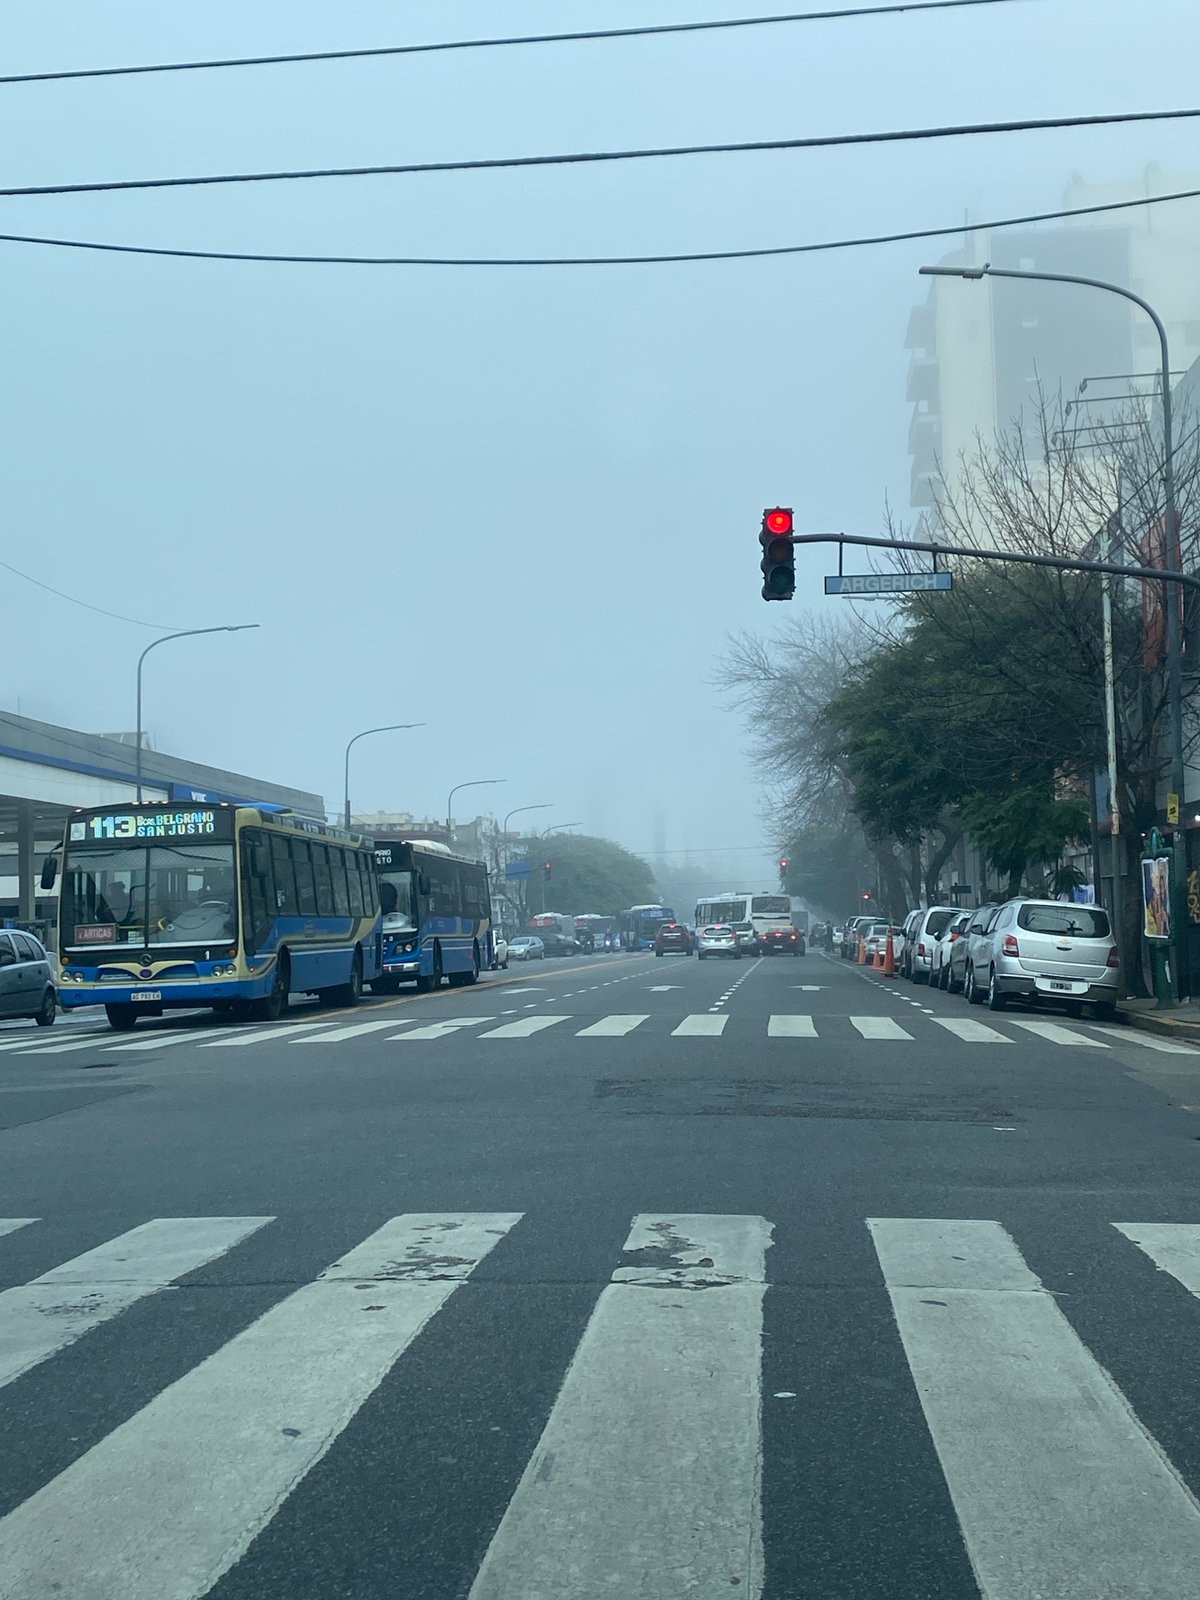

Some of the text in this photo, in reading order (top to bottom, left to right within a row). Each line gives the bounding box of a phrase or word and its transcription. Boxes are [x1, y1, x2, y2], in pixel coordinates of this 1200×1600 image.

[841, 575, 938, 593] ARGERICH
[155, 811, 213, 825] BELGRANO
[90, 816, 137, 838] 113
[137, 822, 213, 837] SAN JUSTO
